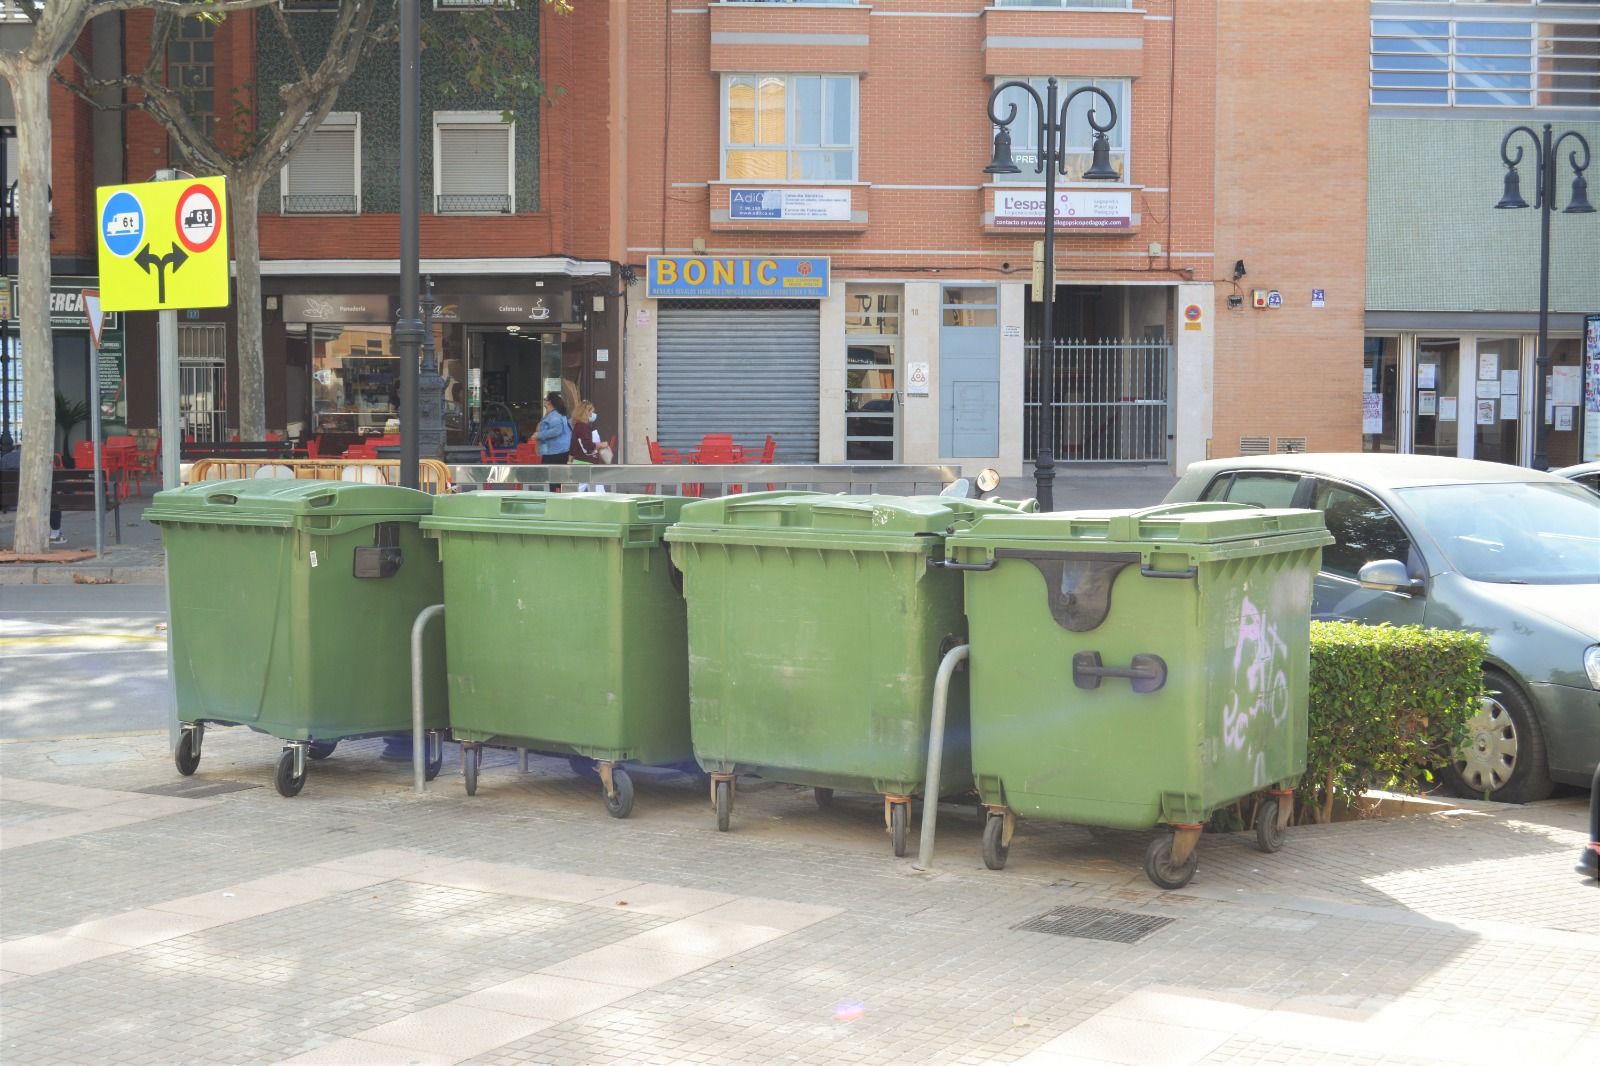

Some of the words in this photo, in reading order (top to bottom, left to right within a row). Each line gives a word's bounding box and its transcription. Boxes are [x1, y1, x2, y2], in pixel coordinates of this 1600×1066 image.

[1004, 196, 1046, 211] L'espa
[656, 258, 778, 286] BONIC
[50, 293, 84, 311] ERCA
